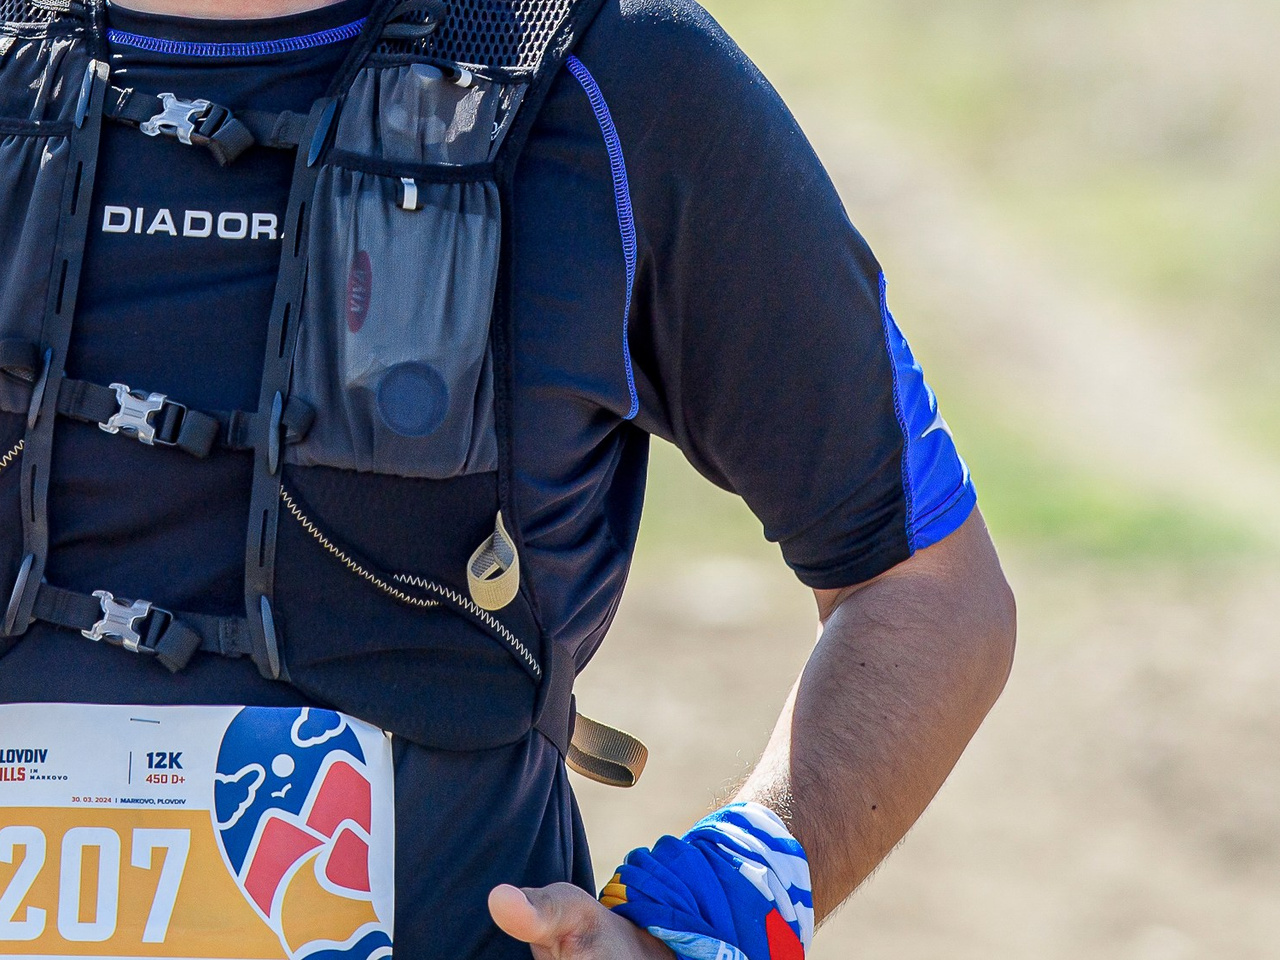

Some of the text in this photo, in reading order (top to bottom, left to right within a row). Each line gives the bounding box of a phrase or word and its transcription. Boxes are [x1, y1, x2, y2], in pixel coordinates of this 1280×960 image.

[102, 205, 285, 240] DIADOR
[146, 751, 183, 769] 12K
[146, 774, 186, 784] 450 D+
[95, 796, 112, 804] 2024
[120, 797, 156, 806] MARKOVO,
